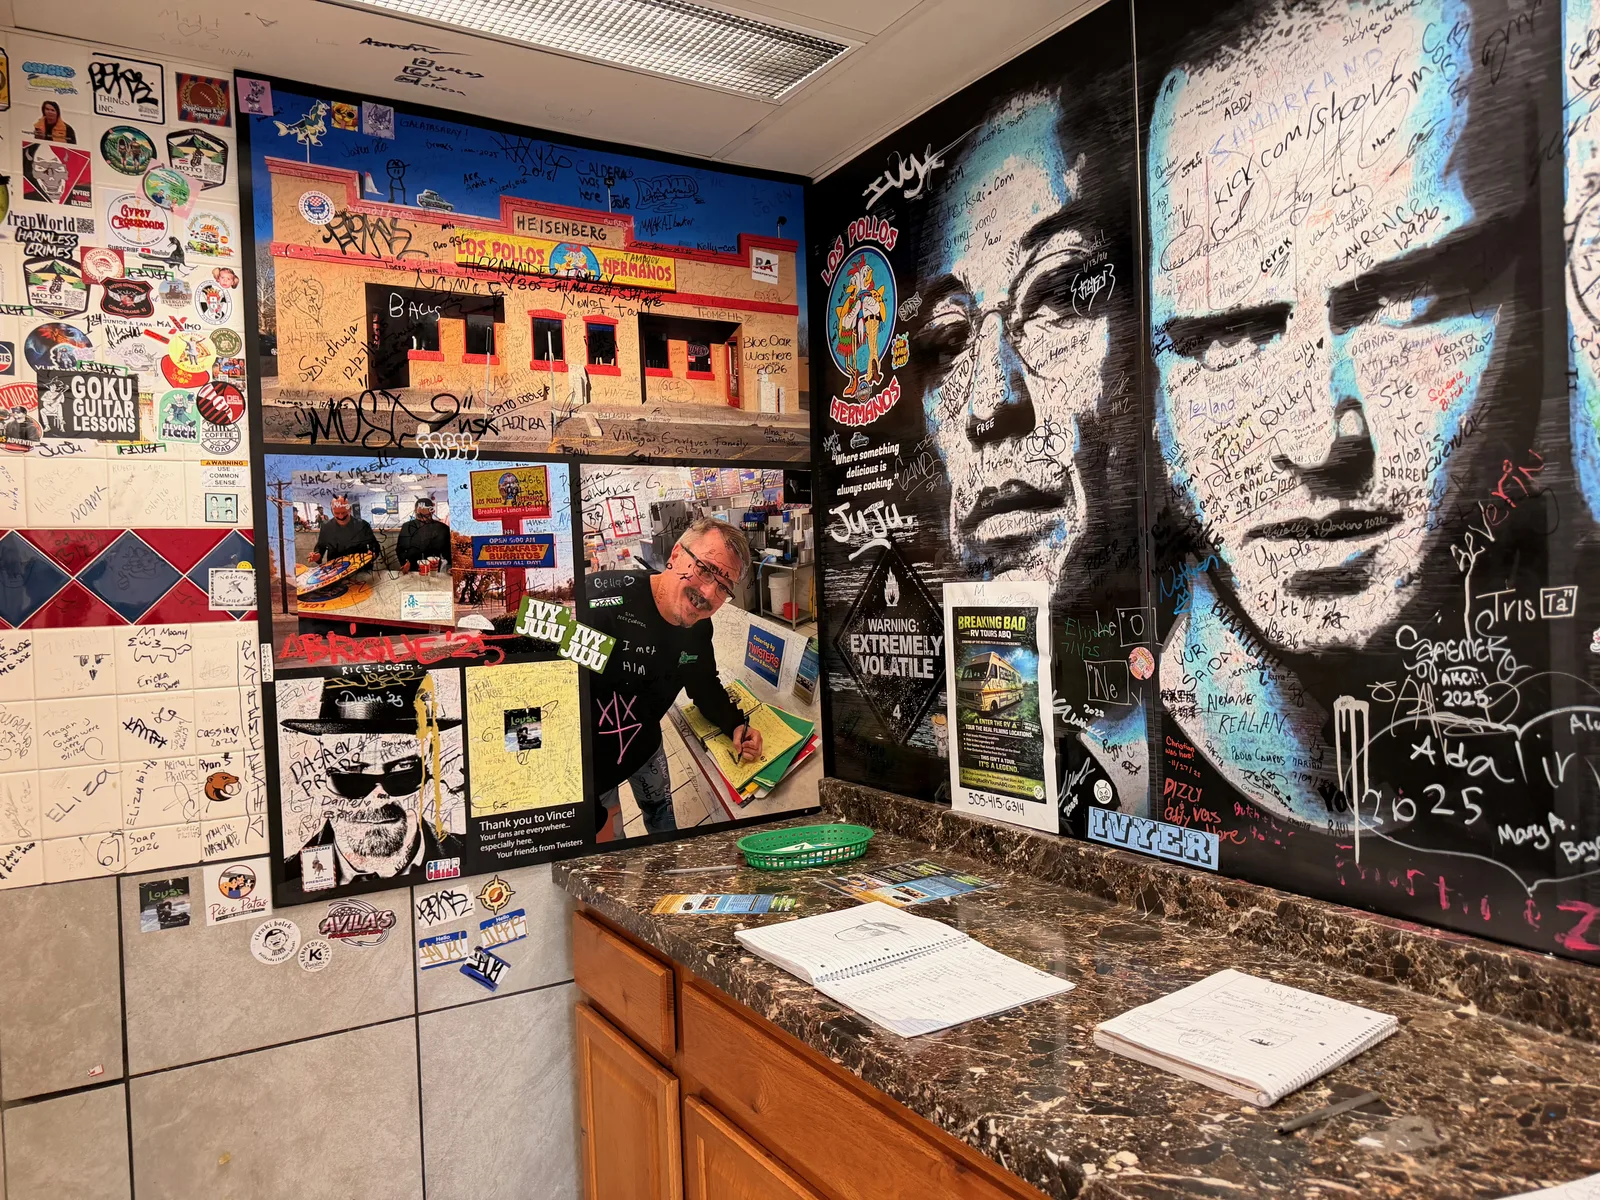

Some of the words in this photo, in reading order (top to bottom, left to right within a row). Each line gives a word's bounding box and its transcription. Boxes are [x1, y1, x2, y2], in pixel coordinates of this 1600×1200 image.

[17, 228, 78, 247] HARMLESS
[516, 214, 608, 241] HEISENBERG
[25, 241, 73, 259] CRIMES
[457, 237, 486, 256] LOS
[491, 240, 545, 265] POLLOS
[602, 257, 672, 282] HERMANOS
[821, 234, 845, 287] LOS
[848, 214, 900, 251] POLLOS
[31, 292, 62, 300] MOTO
[71, 375, 133, 401] GOKU
[72, 399, 135, 419] GUITAR
[829, 375, 902, 427] HERMANOS
[73, 415, 136, 434] LESSONS
[975, 417, 995, 437] FREE
[209, 444, 231, 452] ROAD
[859, 441, 901, 461] something
[846, 464, 877, 479] delicious
[878, 462, 887, 473] is
[836, 483, 865, 497] always
[484, 544, 544, 553] BREAKFAST
[489, 551, 541, 560] BURRITOS
[525, 598, 563, 623] IVY
[516, 616, 567, 643] JUJU
[867, 618, 920, 634] WARNING:
[957, 615, 1003, 630] BREAKING
[1003, 615, 1027, 632] BAD
[571, 624, 607, 650] IVY
[970, 629, 979, 637] RV
[980, 630, 998, 638] TOURS
[998, 630, 1012, 639] ABQ
[748, 641, 780, 669] TWISTERS
[850, 634, 944, 657] EXTREMELY
[560, 641, 608, 671] JUJU
[858, 655, 934, 679] VOLATILE
[994, 719, 1003, 727] THE
[1003, 720, 1011, 728] RV
[480, 818, 510, 832] Thank
[511, 817, 532, 829] you
[533, 815, 545, 825] to
[546, 808, 576, 822] Vince!
[480, 831, 497, 841] Your
[497, 830, 512, 840] fans
[513, 828, 526, 837] are
[480, 839, 512, 853] especially
[513, 836, 534, 847] here.
[496, 849, 514, 859] Your
[514, 845, 539, 857] friends
[539, 843, 555, 853] from
[556, 837, 584, 850] Twisters
[319, 909, 394, 935] AVILA'S
